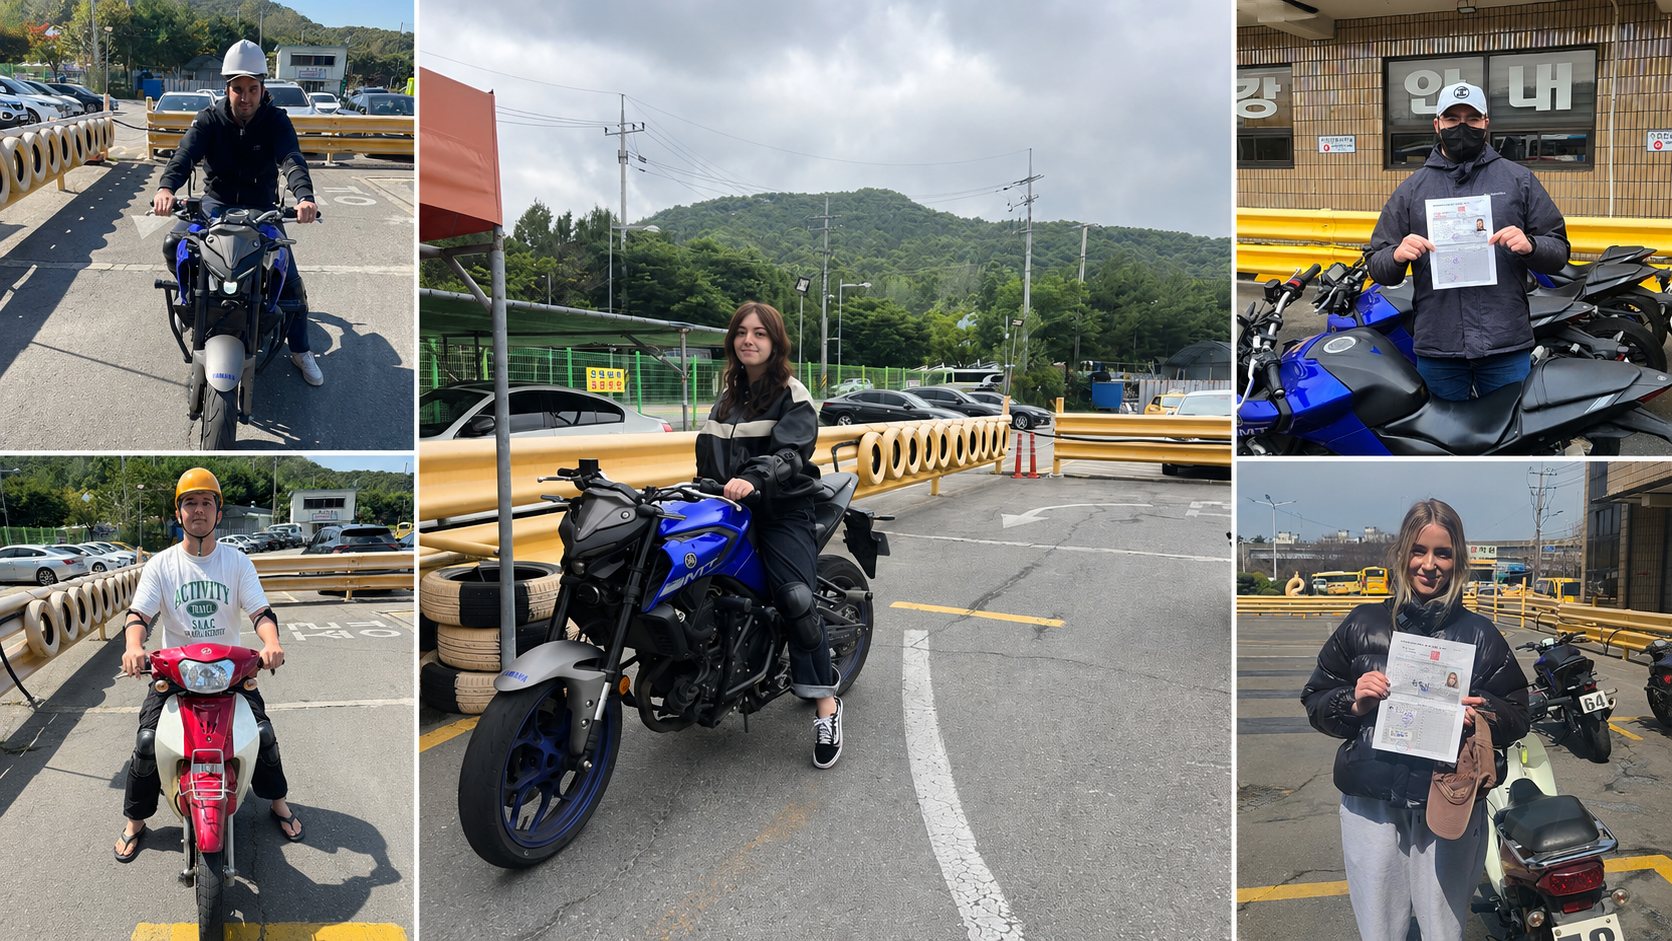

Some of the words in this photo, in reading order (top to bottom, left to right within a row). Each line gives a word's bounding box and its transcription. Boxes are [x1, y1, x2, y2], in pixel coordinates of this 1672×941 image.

[1239, 427, 1268, 436] MT
[175, 581, 229, 610] ACTIVITY
[1584, 694, 1606, 711] 64
